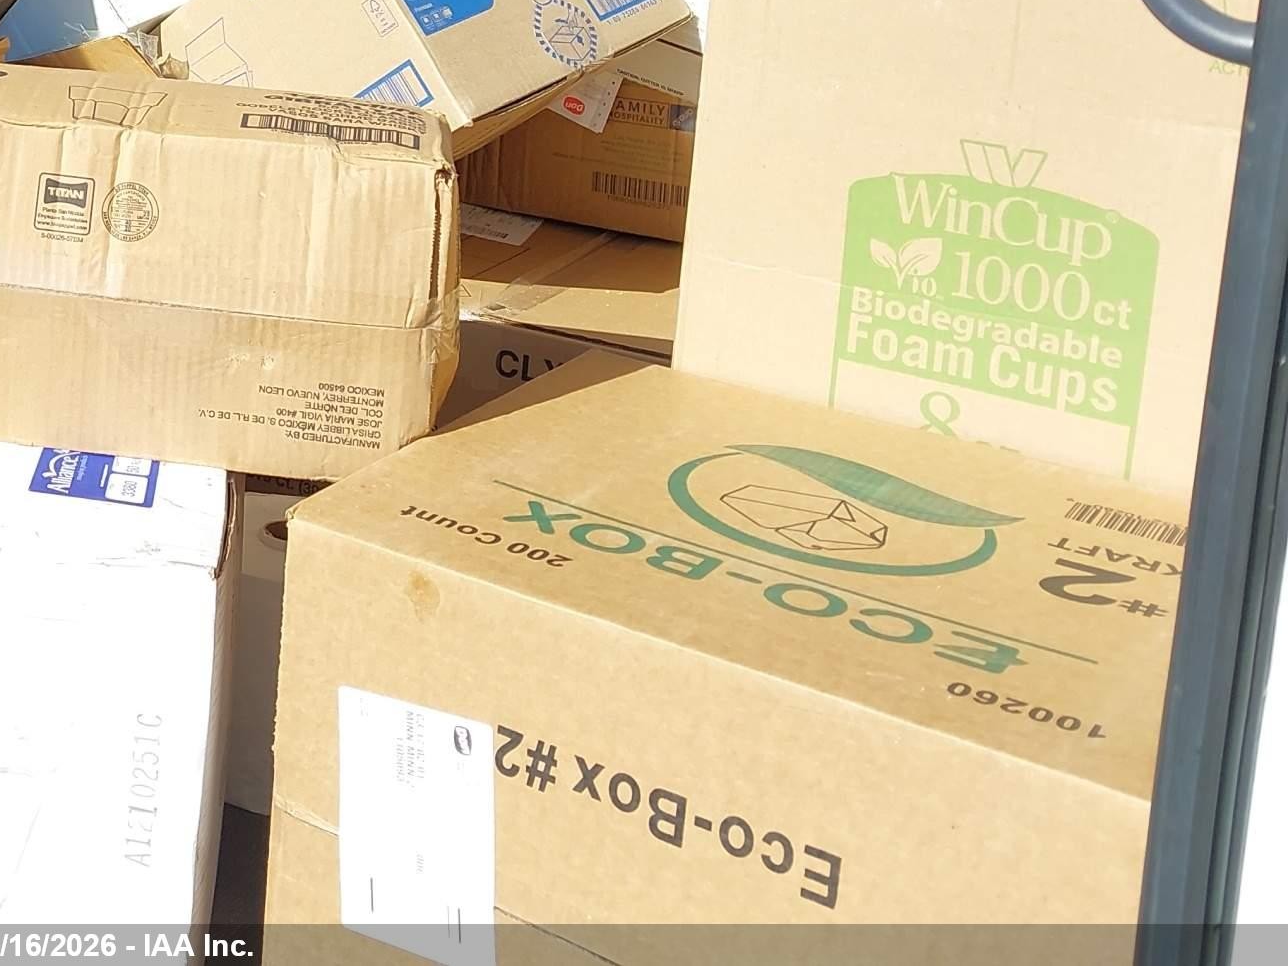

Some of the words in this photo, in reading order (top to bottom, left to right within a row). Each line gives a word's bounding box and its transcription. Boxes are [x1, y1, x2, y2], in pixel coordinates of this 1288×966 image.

[616, 101, 665, 115] AMILY
[613, 111, 665, 126] OSPITALITY
[890, 172, 1112, 267] WinCup
[952, 251, 1090, 321] 1000
[1093, 298, 1131, 330] ct
[851, 286, 1123, 369] Biodegradable
[847, 312, 974, 381] Foam
[988, 344, 1118, 412] Cups
[258, 384, 285, 396] LEON
[286, 388, 320, 400] NUEVO
[318, 382, 345, 393] 64500
[347, 385, 385, 397] MEXICO
[276, 408, 297, 418] #400
[304, 401, 338, 413] NORTE
[340, 405, 359, 415] DEL
[218, 410, 230, 420] DE
[252, 415, 265, 424] DE
[299, 410, 323, 422] VIGIL
[317, 424, 350, 436] LIBBEY
[352, 429, 381, 439] CRISA
[302, 432, 380, 449] MANUFACTURED
[47, 452, 80, 494] Alliance
[400, 504, 502, 548] Count
[507, 540, 573, 569] 200
[1039, 558, 1169, 618] #2
[945, 681, 1108, 739] 100260
[494, 724, 558, 794] #2
[574, 754, 842, 910] Eco-Box
